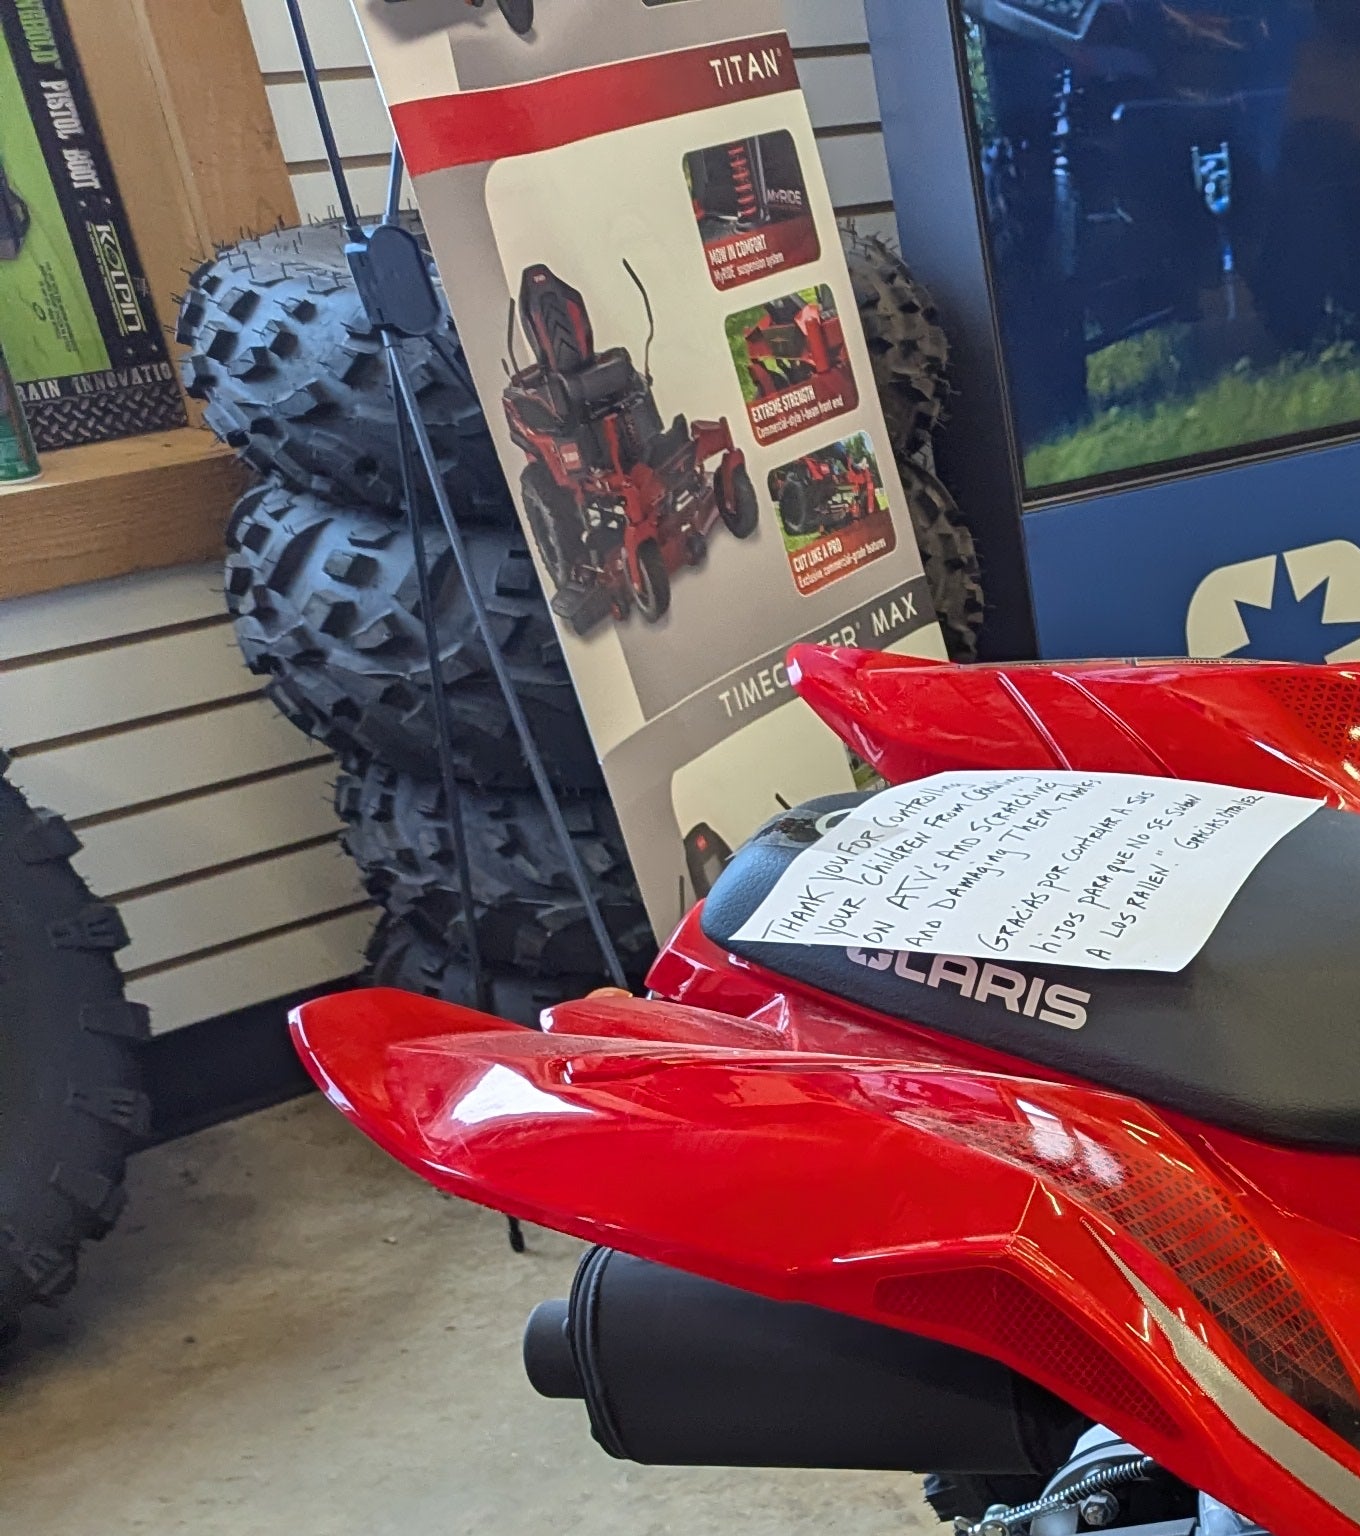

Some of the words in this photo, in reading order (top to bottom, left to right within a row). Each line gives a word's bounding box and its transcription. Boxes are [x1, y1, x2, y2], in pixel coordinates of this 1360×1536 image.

[709, 49, 780, 88] TITAN
[40, 80, 85, 139] PISTOL
[62, 148, 101, 189] BOOT
[792, 552, 810, 572] CUT
[806, 546, 823, 566] LIKE
[820, 543, 829, 560] A
[826, 536, 843, 557] PRO
[719, 627, 858, 717] TIMECER
[871, 592, 918, 637] MAX
[1147, 808, 1173, 831] SE
[863, 920, 896, 944] ON
[1086, 947, 1111, 961] A
[846, 946, 1091, 1030] OLARIS
